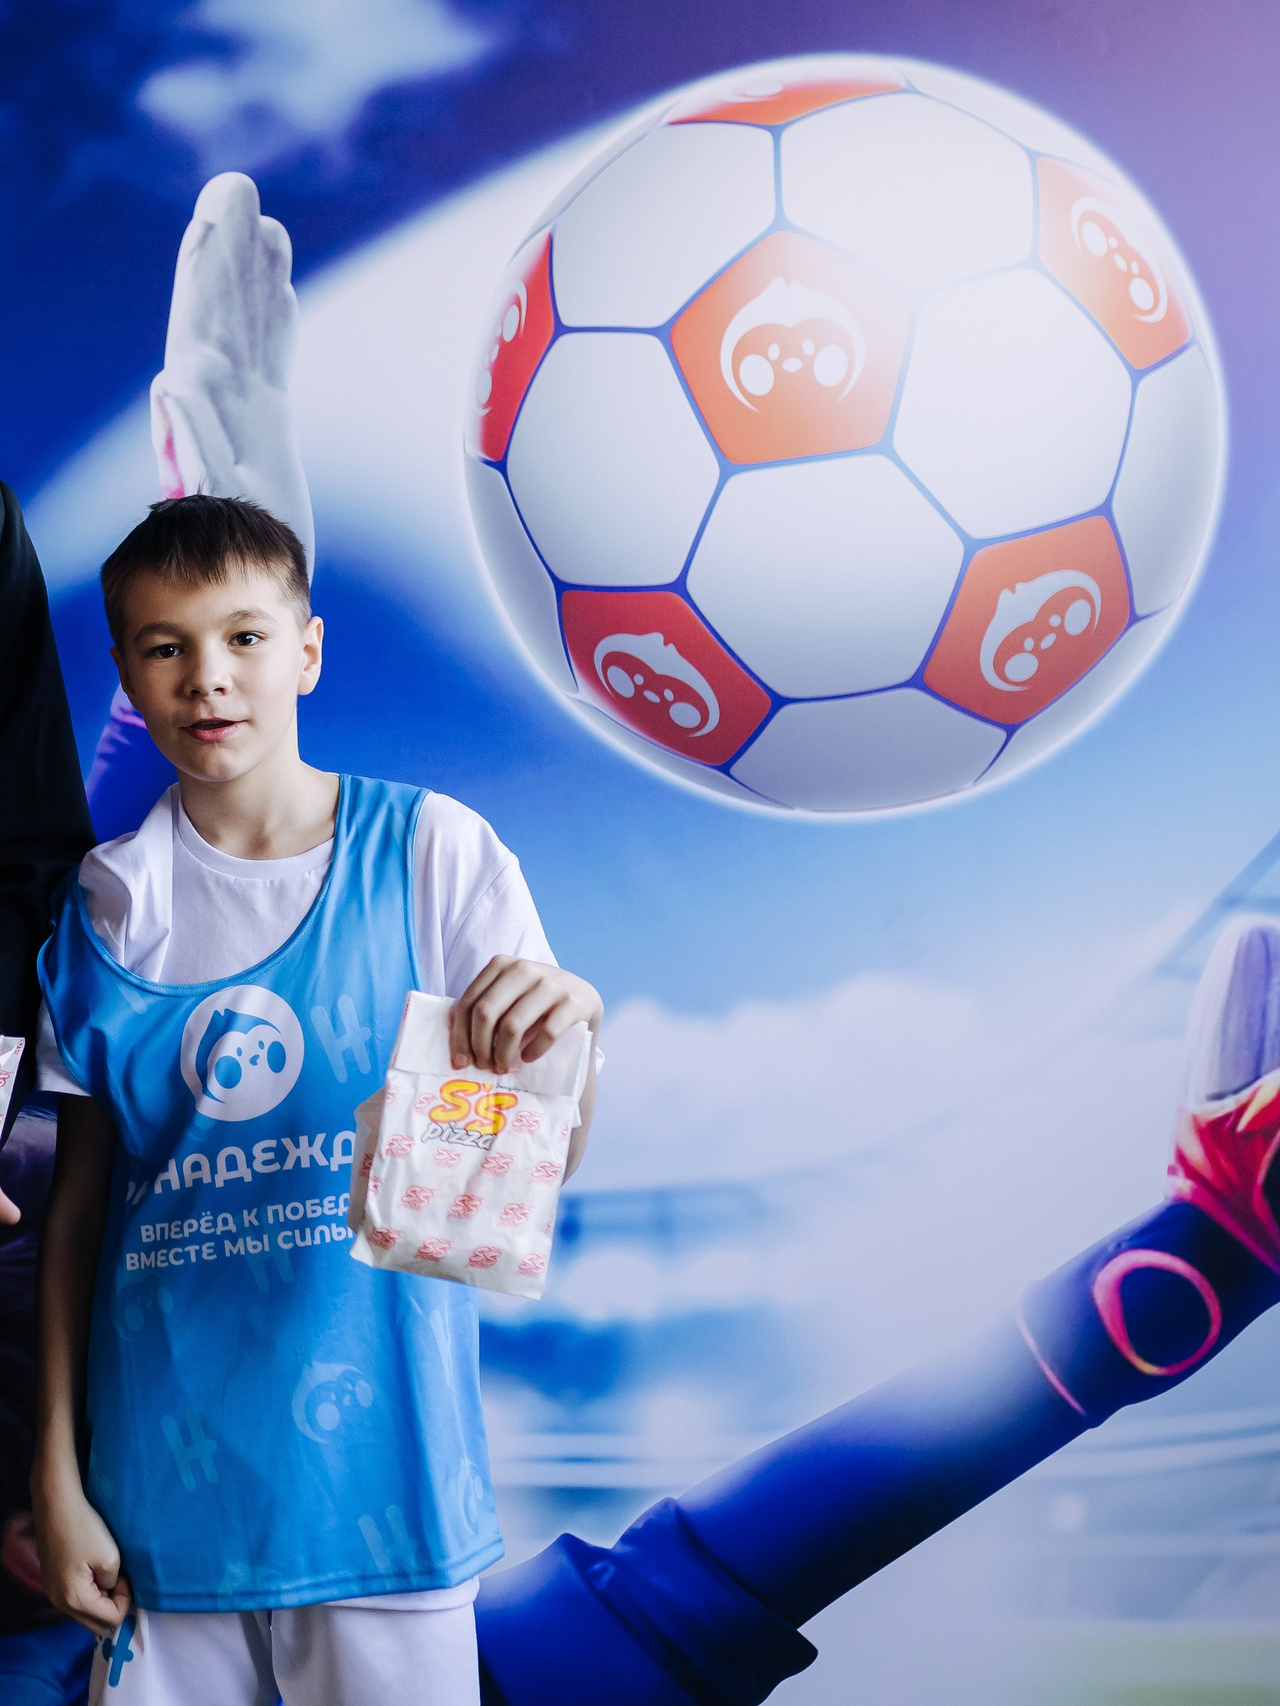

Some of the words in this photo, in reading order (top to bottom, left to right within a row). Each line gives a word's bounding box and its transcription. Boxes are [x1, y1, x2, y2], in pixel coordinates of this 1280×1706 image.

[140, 1211, 236, 1243] ВПЕРЁД
[243, 1208, 260, 1227] К
[126, 1242, 217, 1271] ВМЕСТЕ
[224, 1234, 269, 1258] МЫ
